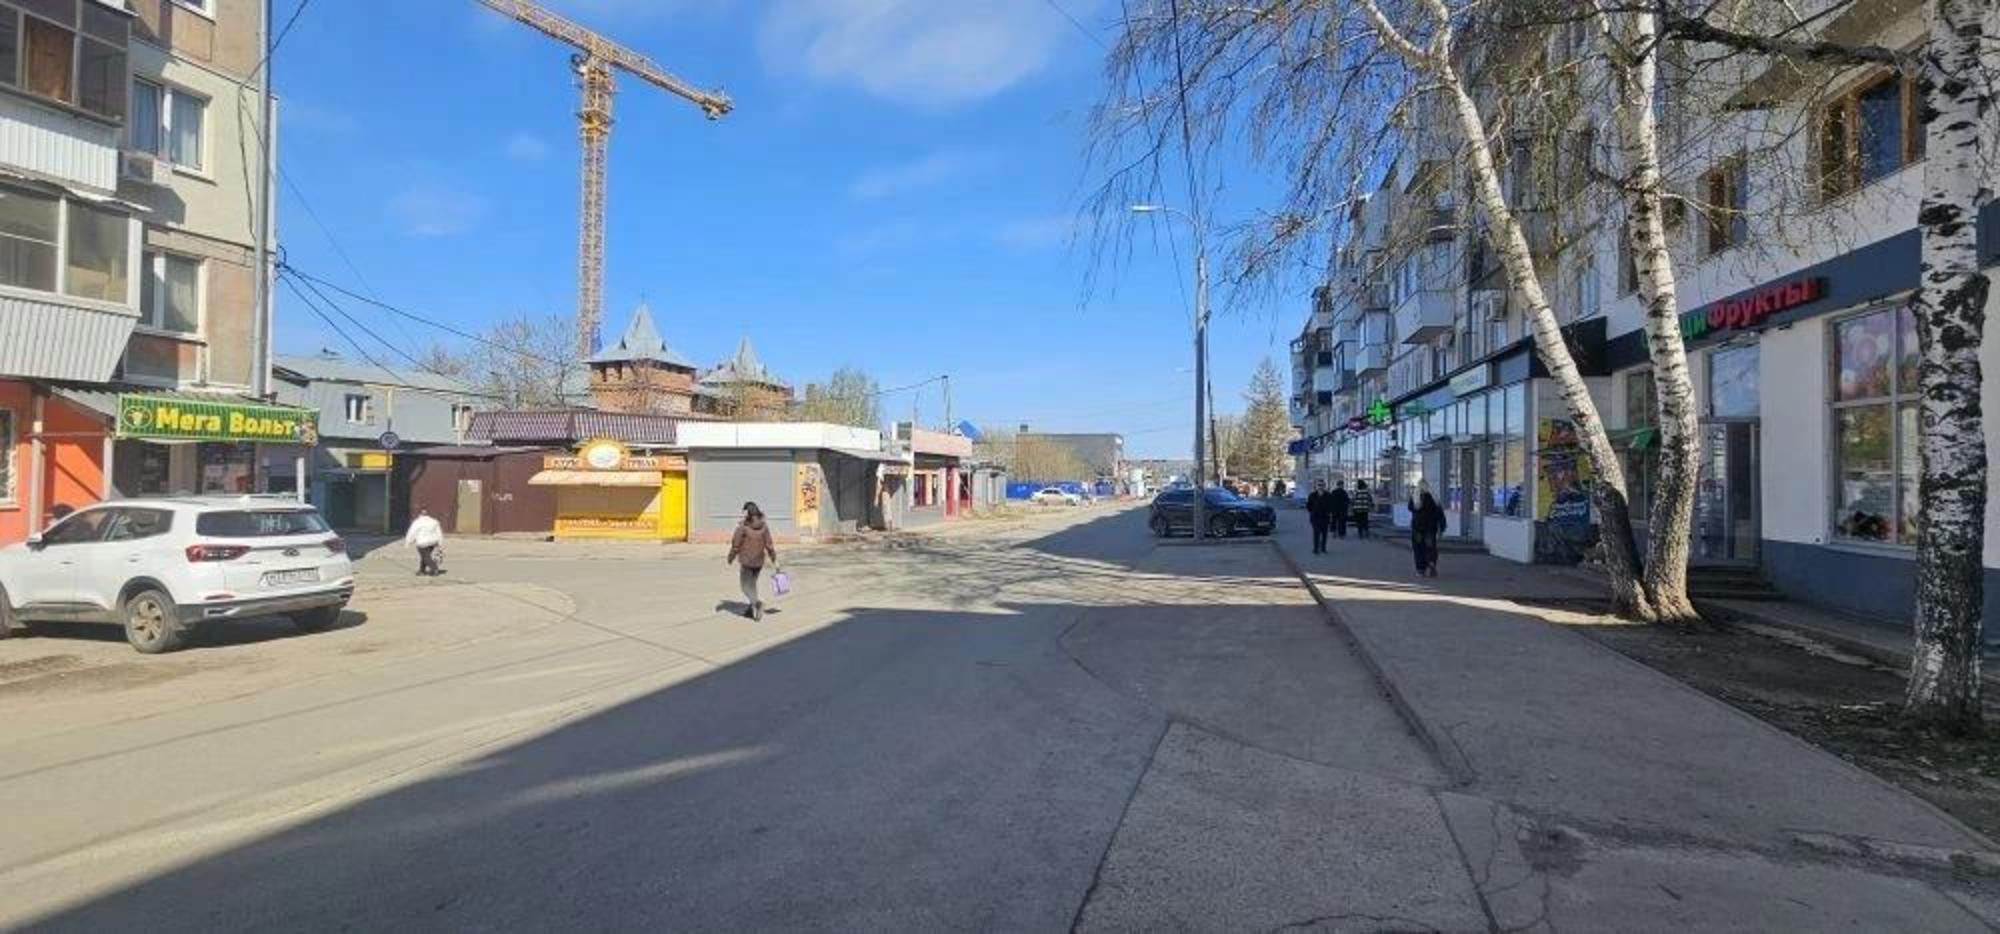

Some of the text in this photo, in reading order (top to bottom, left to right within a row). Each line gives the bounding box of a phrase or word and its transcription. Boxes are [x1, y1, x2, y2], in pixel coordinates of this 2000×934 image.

[1708, 279, 1822, 328] Фрукты
[156, 408, 296, 435] Мега Вольт
